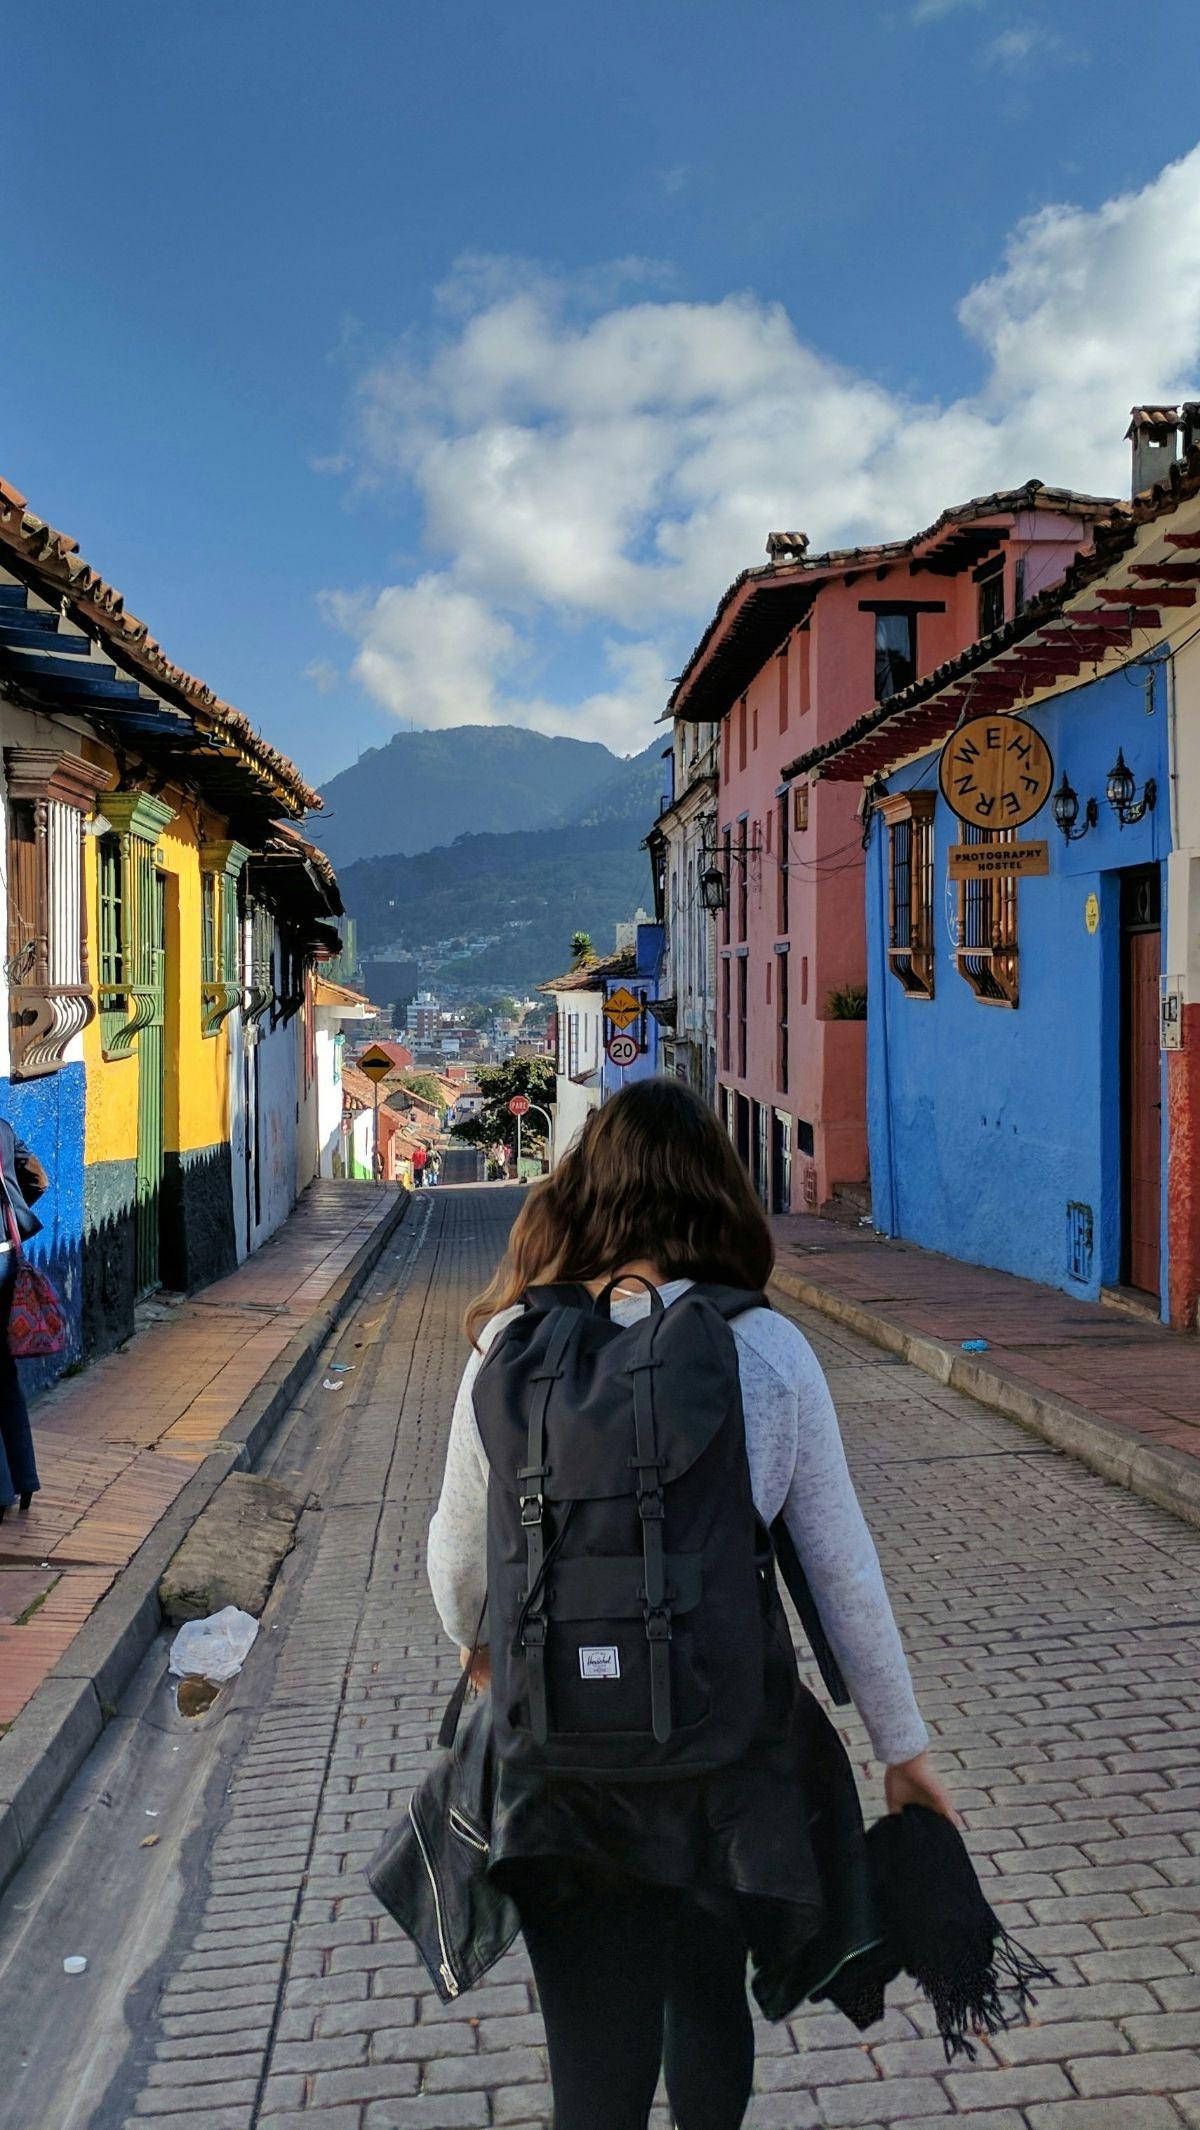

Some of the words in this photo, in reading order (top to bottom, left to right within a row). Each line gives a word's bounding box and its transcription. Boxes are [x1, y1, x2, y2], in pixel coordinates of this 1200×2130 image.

[955, 849, 1042, 862] PHOTOGRAPHY
[978, 861, 1023, 871] HOSTEL
[612, 1042, 633, 1058] 20
[511, 1101, 526, 1110] PARE
